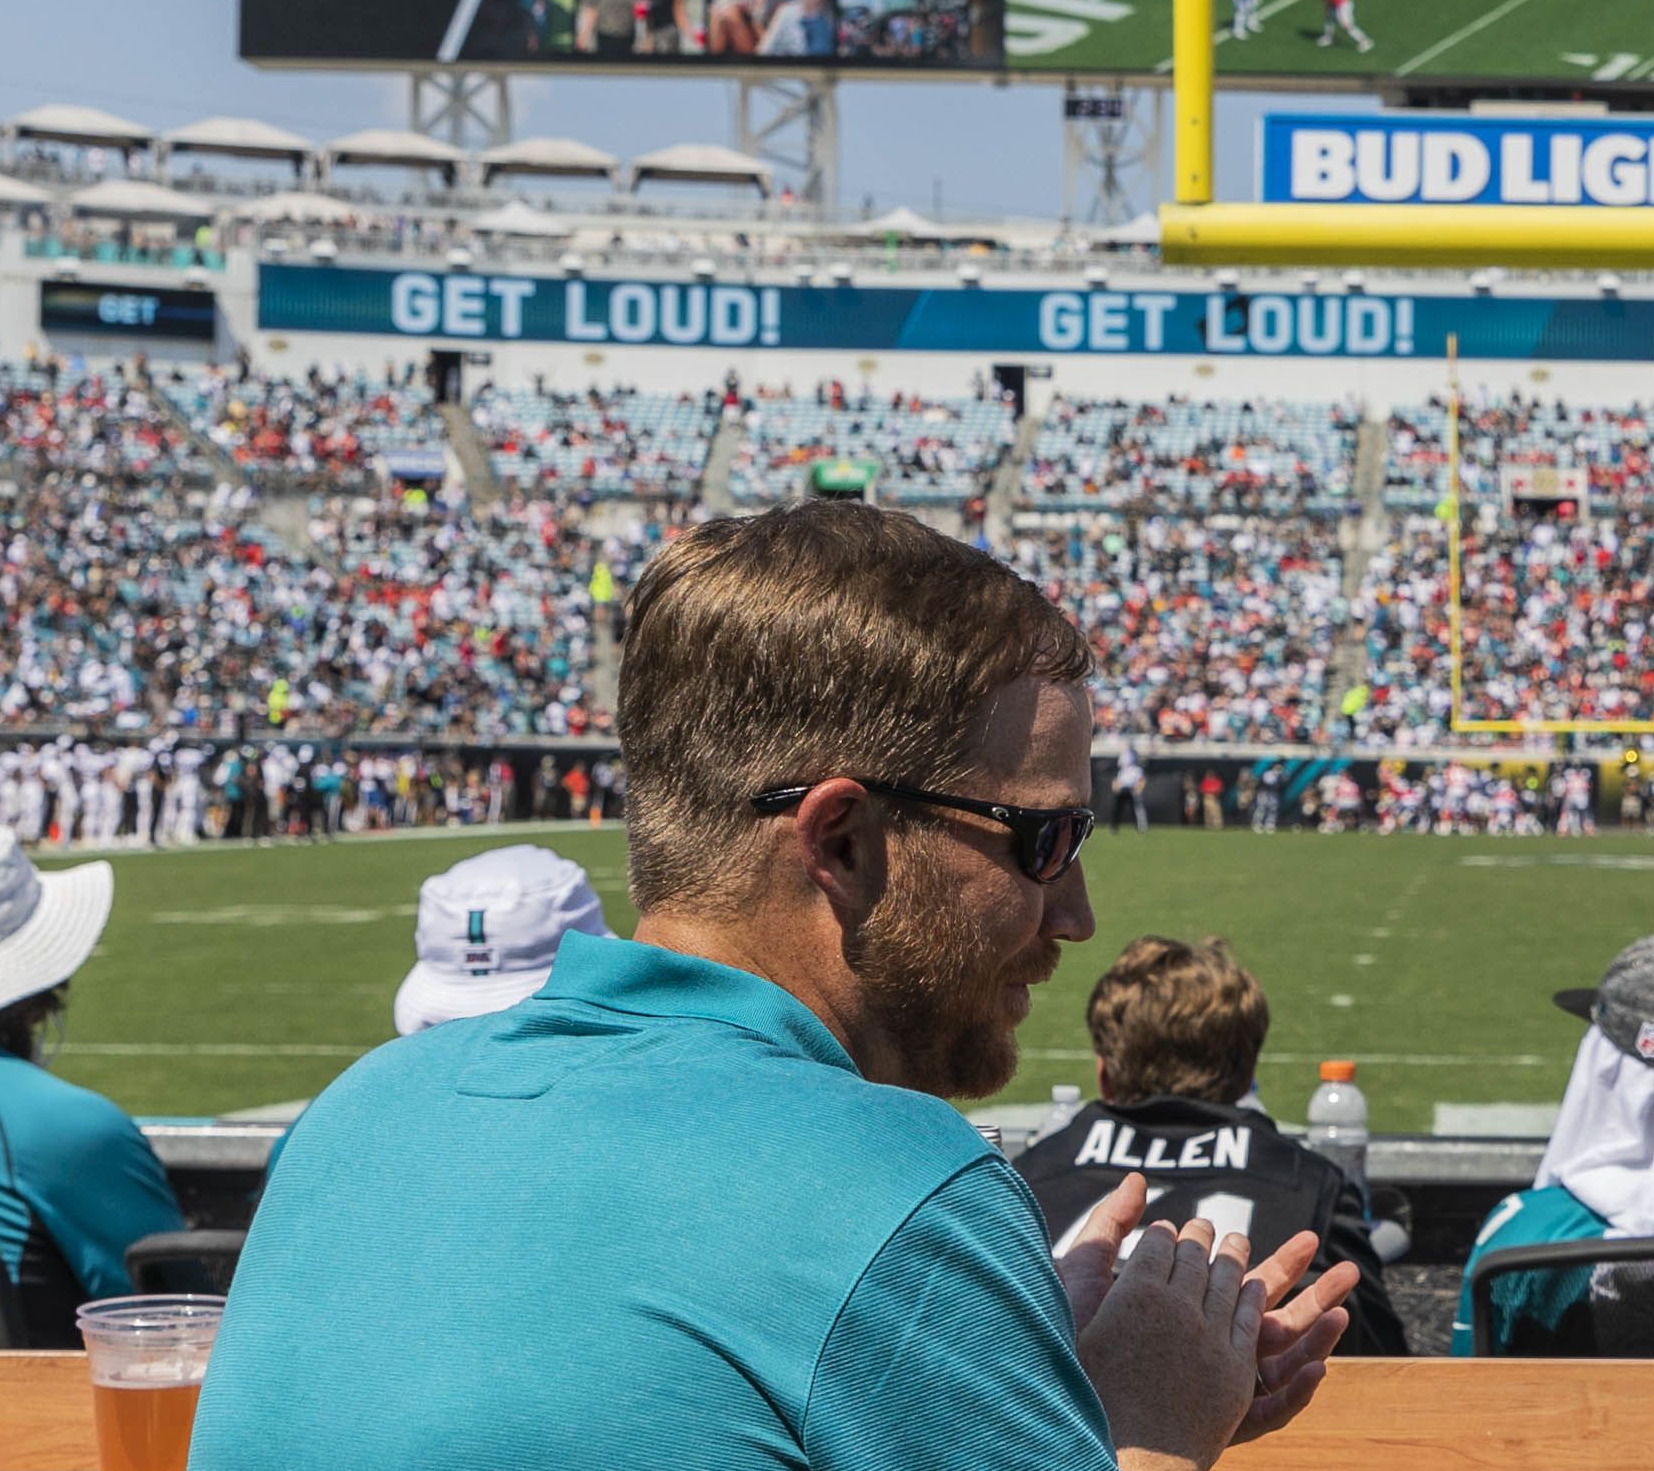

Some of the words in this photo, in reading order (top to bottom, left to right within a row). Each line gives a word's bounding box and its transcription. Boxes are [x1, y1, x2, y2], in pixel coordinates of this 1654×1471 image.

[1291, 130, 1490, 203] BUD
[98, 292, 160, 326] GET
[391, 272, 536, 338] GET
[565, 280, 781, 347] LOUD!
[1039, 293, 1177, 351] GET
[1205, 295, 1415, 356] LOUD!
[1074, 1119, 1252, 1170] ALLEN
